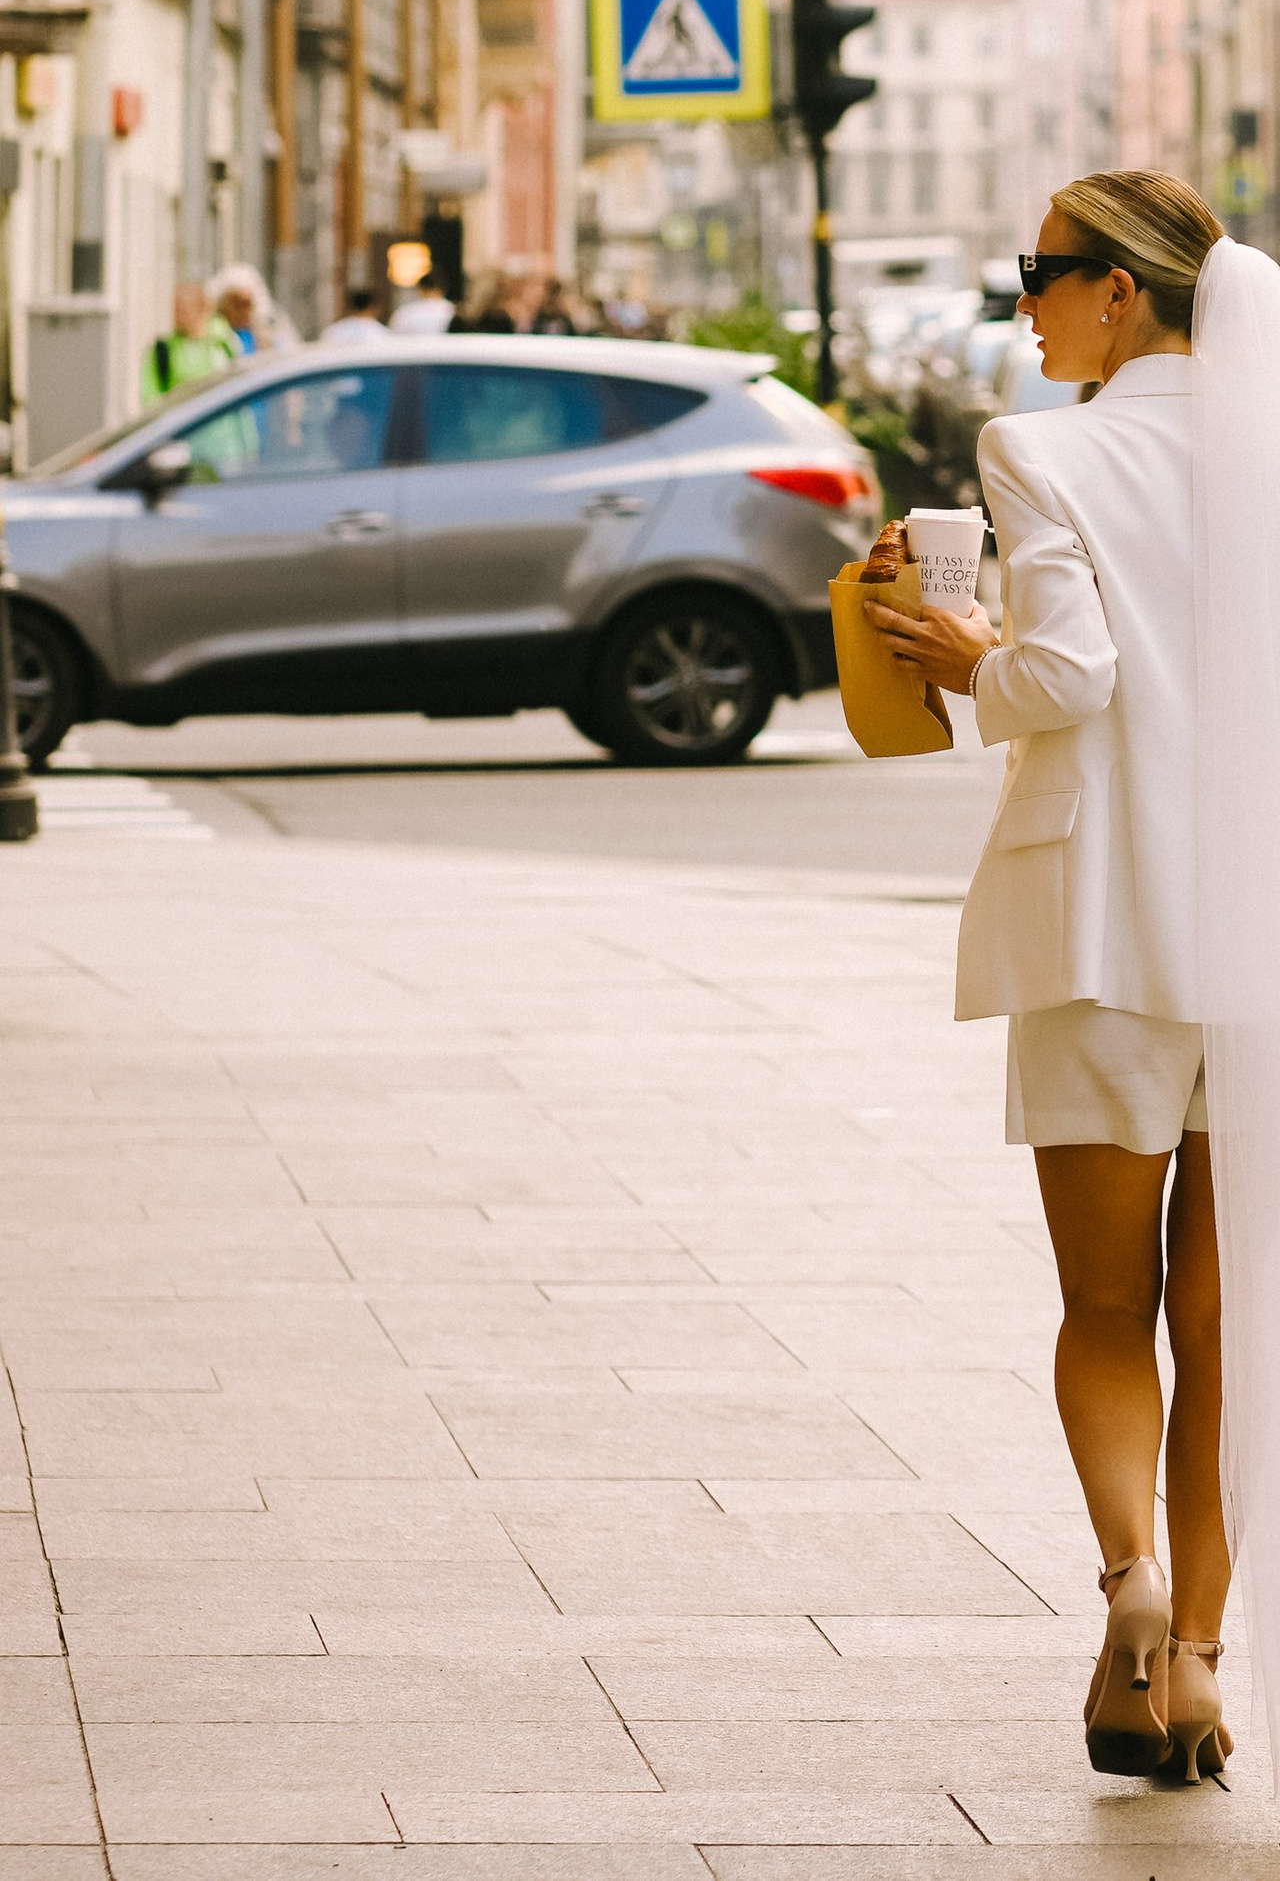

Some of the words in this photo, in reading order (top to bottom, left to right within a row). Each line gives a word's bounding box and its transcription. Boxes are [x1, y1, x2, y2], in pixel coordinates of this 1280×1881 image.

[1023, 255, 1036, 271] B
[935, 556, 966, 567] EASY
[934, 583, 963, 594] EASY
